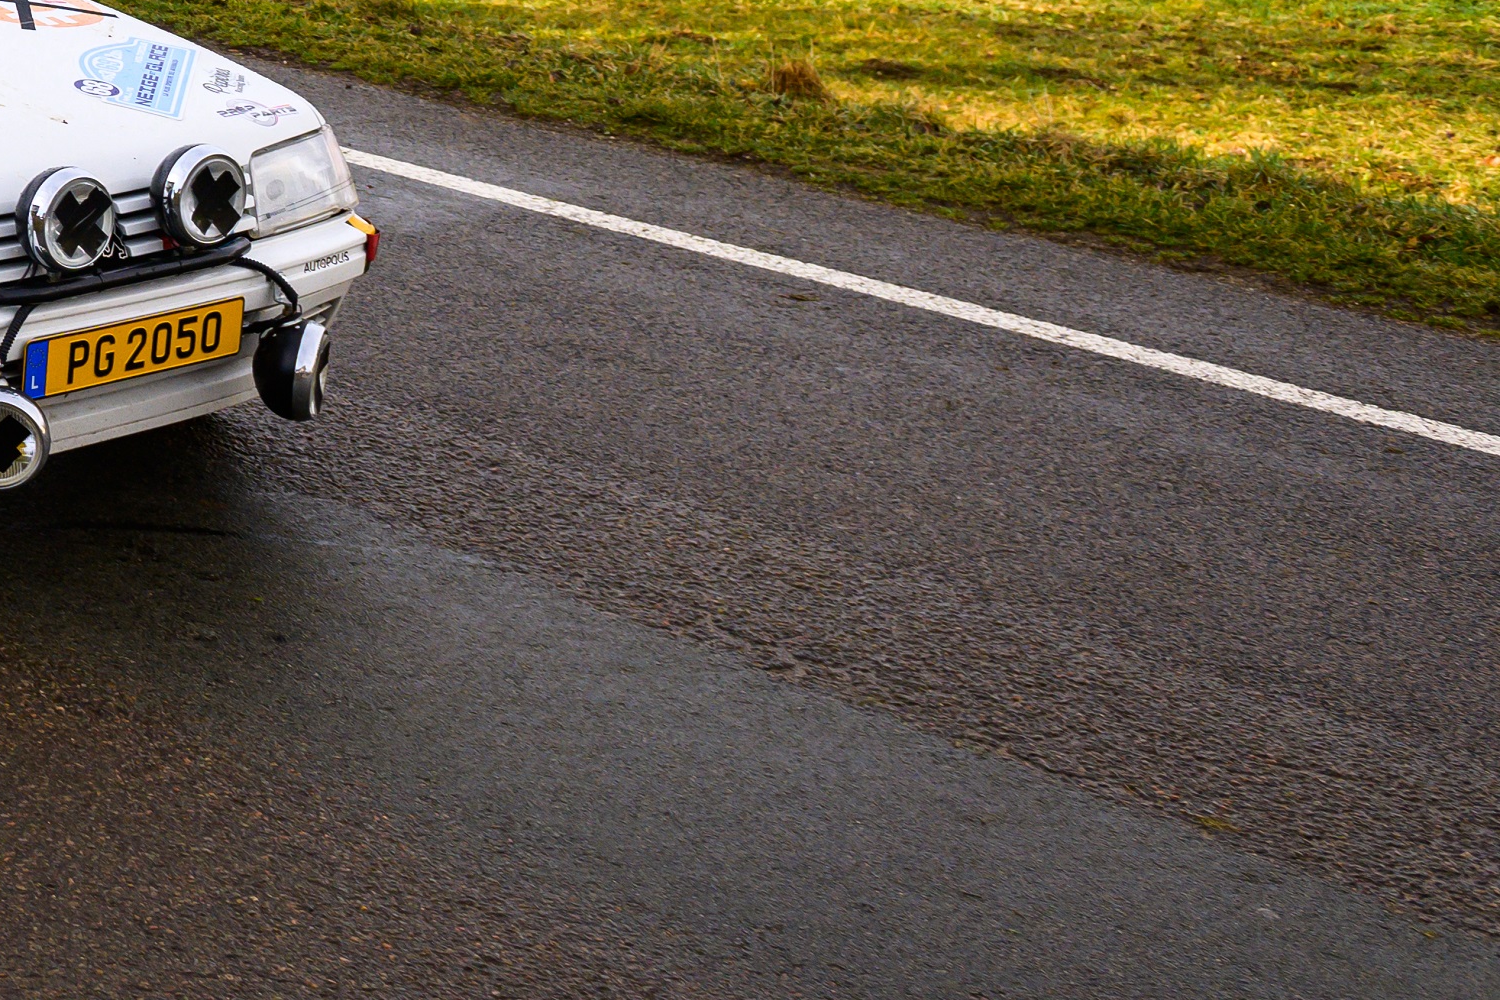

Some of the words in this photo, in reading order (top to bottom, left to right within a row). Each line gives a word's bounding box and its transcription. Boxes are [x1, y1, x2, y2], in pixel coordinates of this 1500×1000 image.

[144, 44, 169, 72] GLACE
[80, 79, 114, 96] 68
[135, 73, 160, 107] NEIGE
[303, 251, 350, 273] AUTOPOLIS
[66, 333, 116, 385] PG
[125, 310, 223, 372] 2050
[31, 375, 39, 390] L
